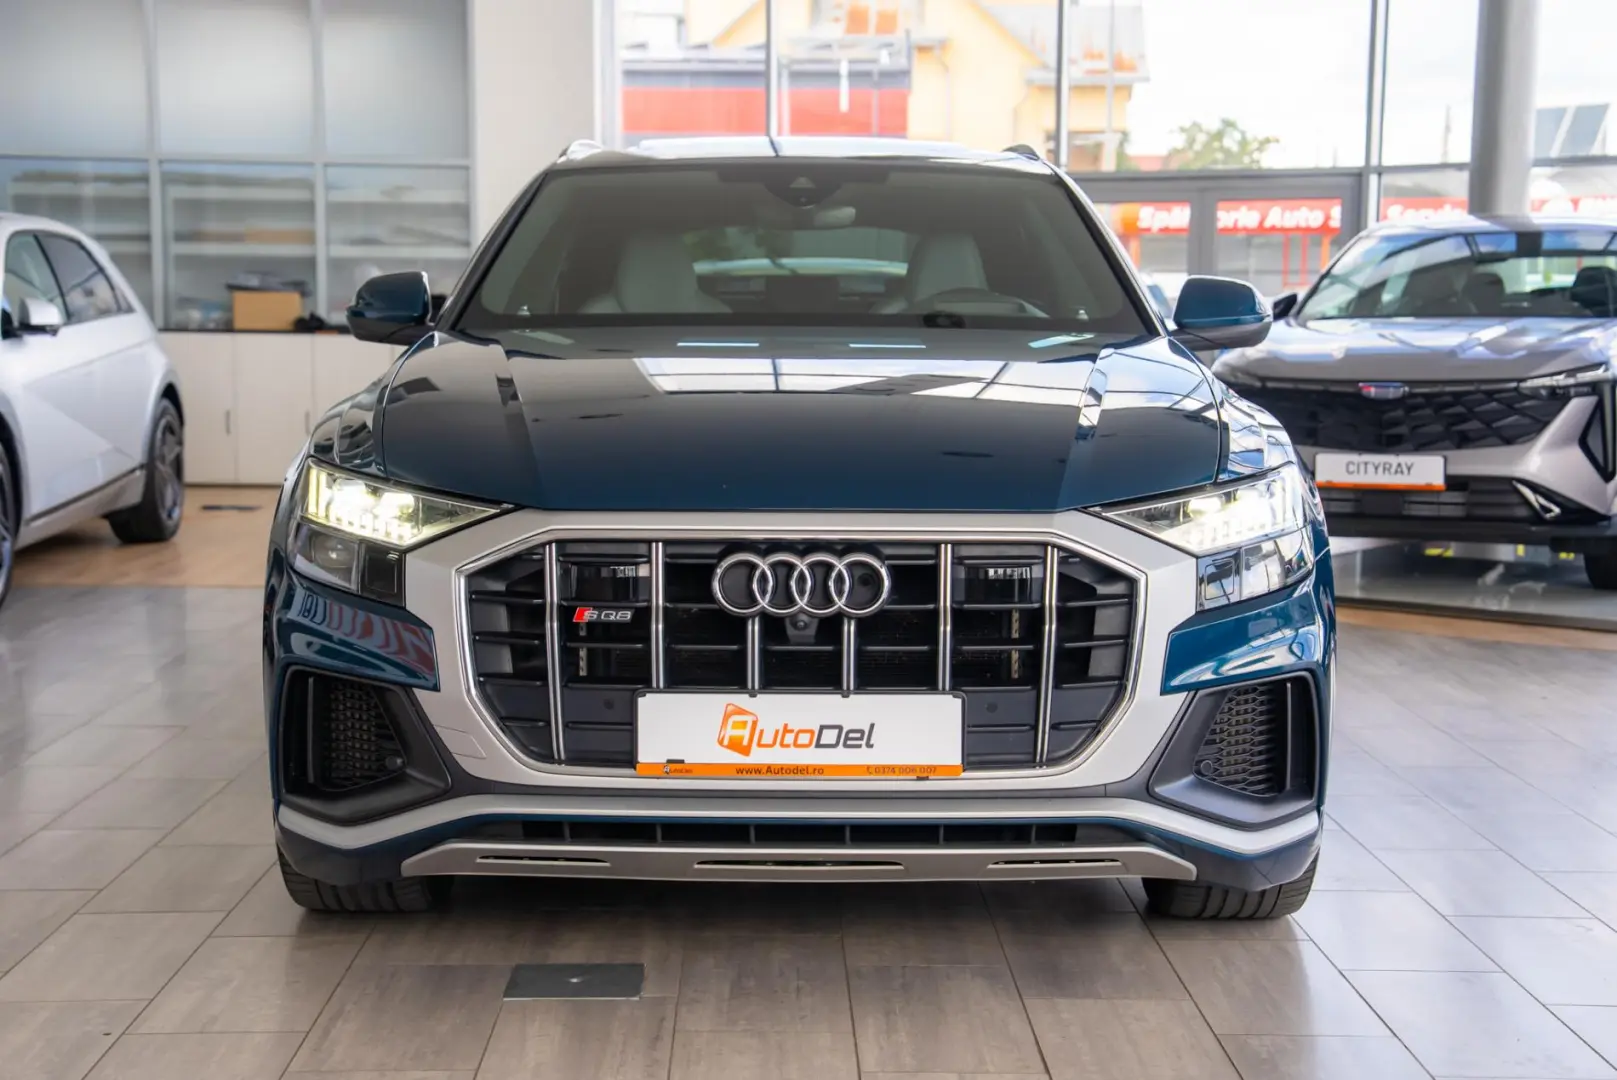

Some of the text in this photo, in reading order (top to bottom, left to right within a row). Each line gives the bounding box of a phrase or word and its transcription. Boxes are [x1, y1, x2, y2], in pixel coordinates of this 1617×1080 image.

[1262, 205, 1325, 229] Auto
[1345, 460, 1414, 476] CITYRAY
[583, 610, 631, 621] SQ8
[720, 711, 875, 752] AutoDel
[735, 765, 825, 775] www.Autodel.ro
